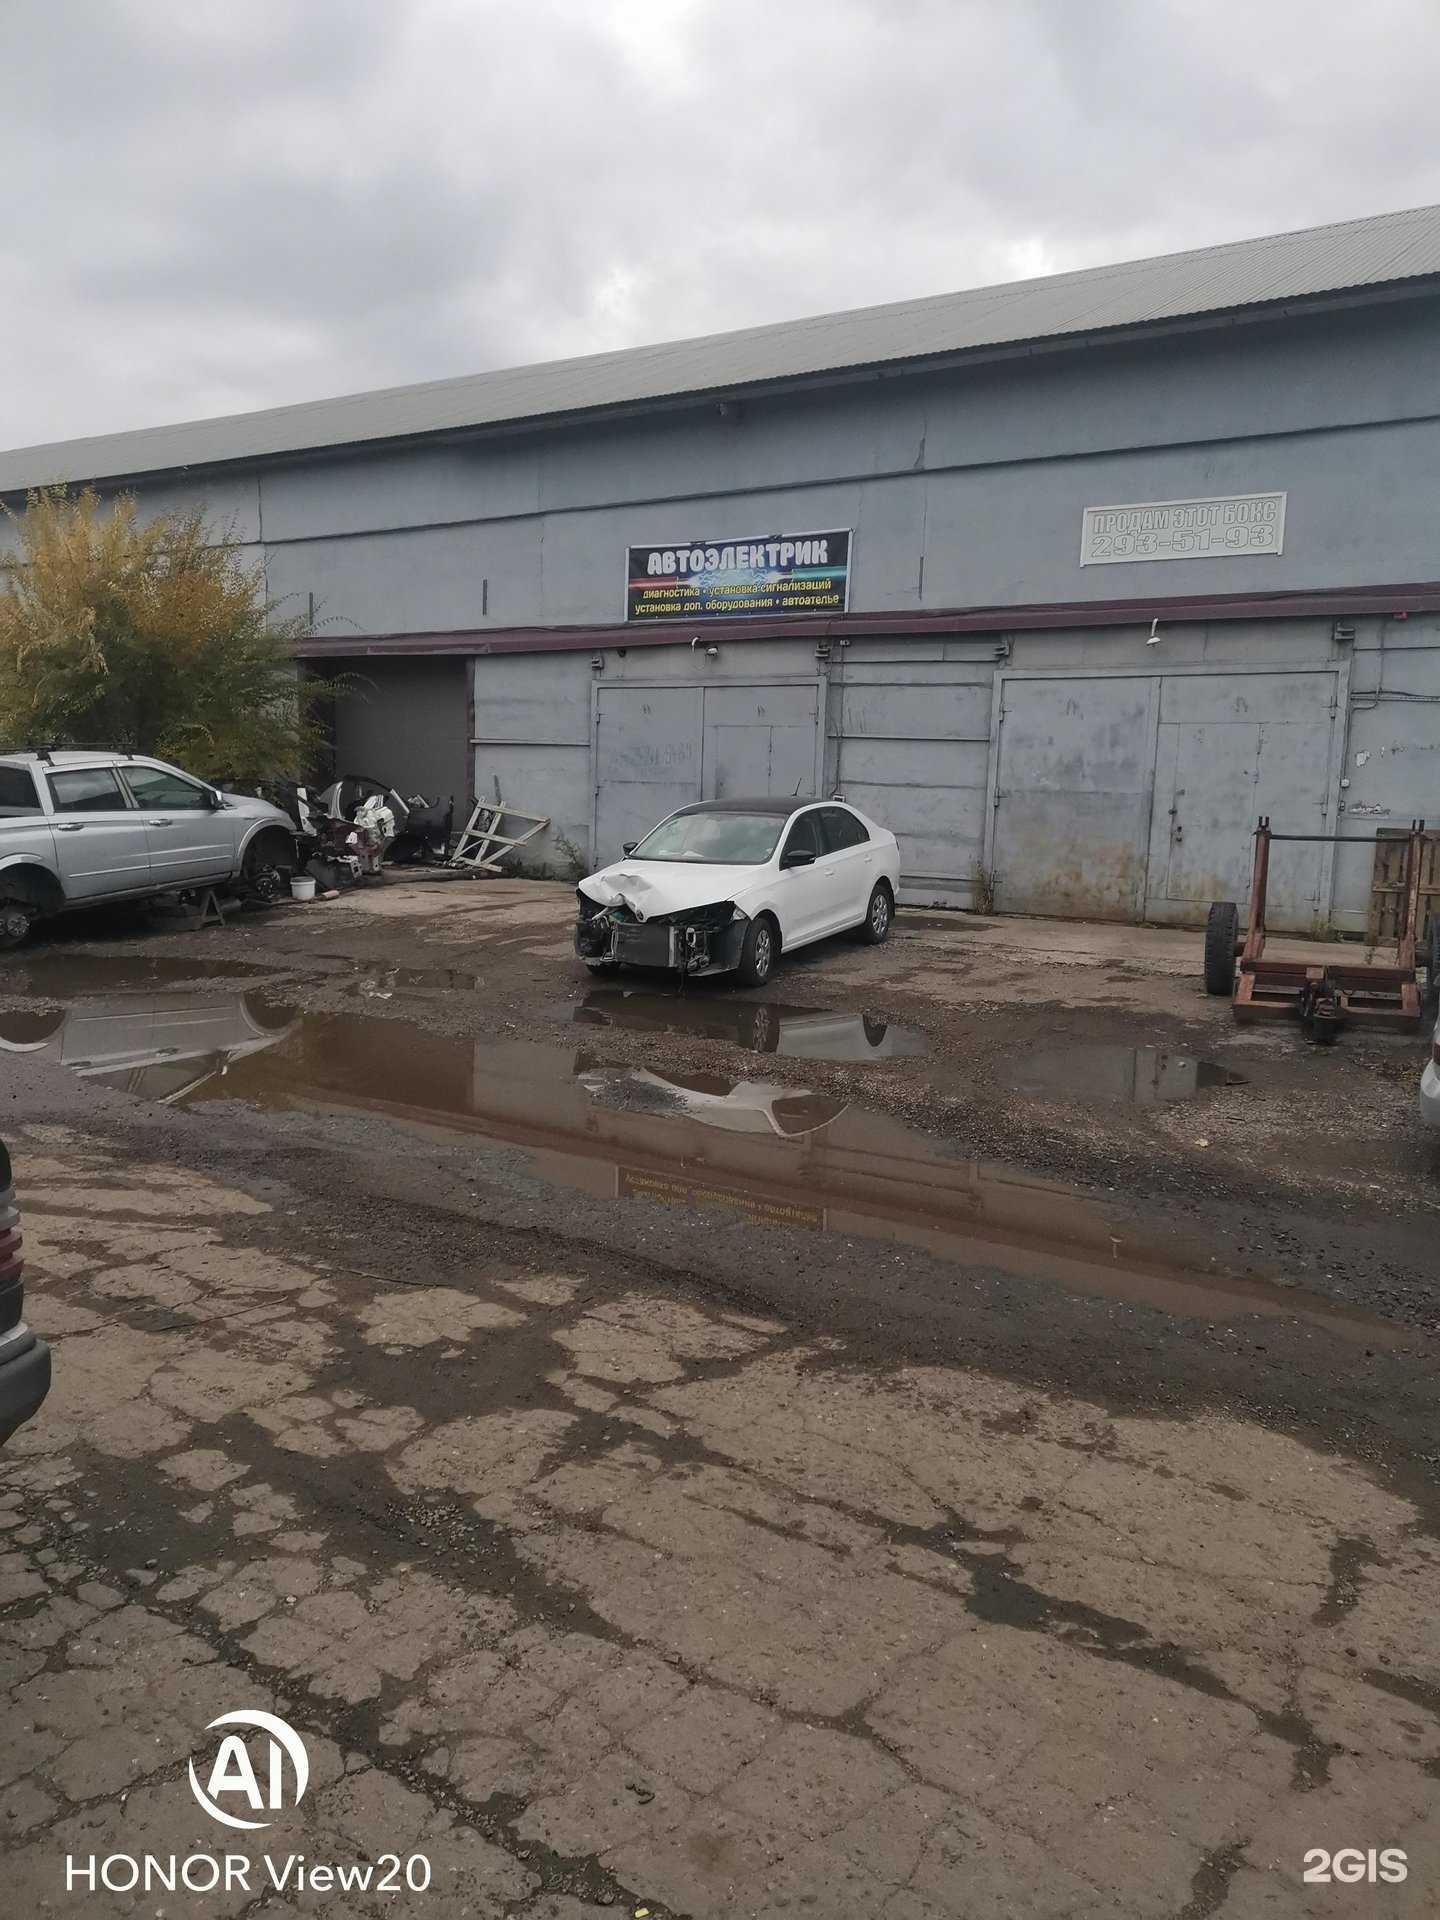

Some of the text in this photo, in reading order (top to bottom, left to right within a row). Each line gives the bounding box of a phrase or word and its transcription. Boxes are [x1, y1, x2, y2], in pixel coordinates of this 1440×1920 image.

[1093, 499, 1276, 535] ПРОДАМ ЭТОТ БОКС
[647, 539, 828, 575] АВТОЭЛЕКТРИК
[1091, 525, 1274, 558] 293-51-93
[635, 594, 839, 615] установка доп. оборудования автоателье
[643, 578, 832, 599] диагностика установка сигнализаций
